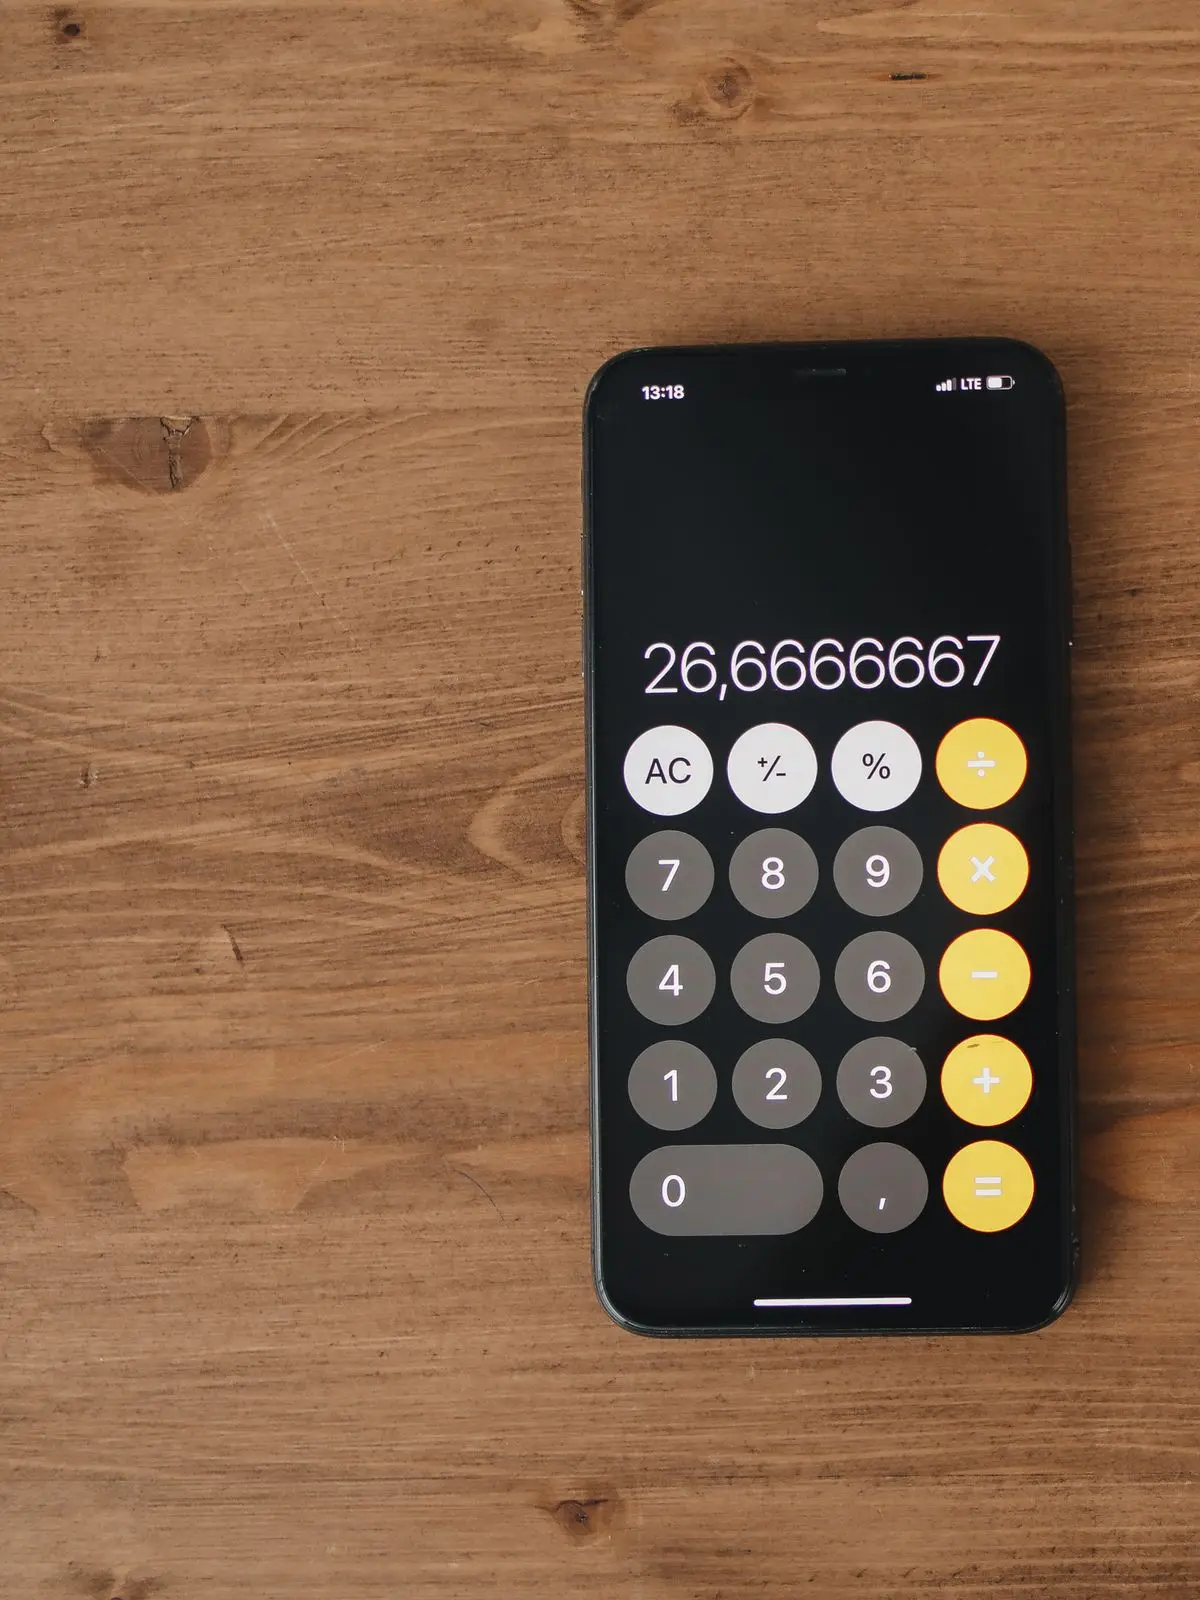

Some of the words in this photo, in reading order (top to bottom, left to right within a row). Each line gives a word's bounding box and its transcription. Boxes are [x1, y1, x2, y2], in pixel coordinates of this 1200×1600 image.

[642, 385, 685, 400] 13:18
[960, 377, 982, 391] LTE
[644, 635, 1001, 701] 26,6666667
[644, 757, 692, 785] AC
[658, 859, 681, 892] 7
[761, 856, 786, 890] 8
[865, 854, 890, 888] 9
[658, 964, 684, 996] 4
[763, 962, 787, 995] 5
[867, 960, 891, 993] 6
[663, 1069, 679, 1102] 1
[765, 1067, 788, 1101] 2
[869, 1065, 893, 1099] 3
[661, 1174, 686, 1207] 0
